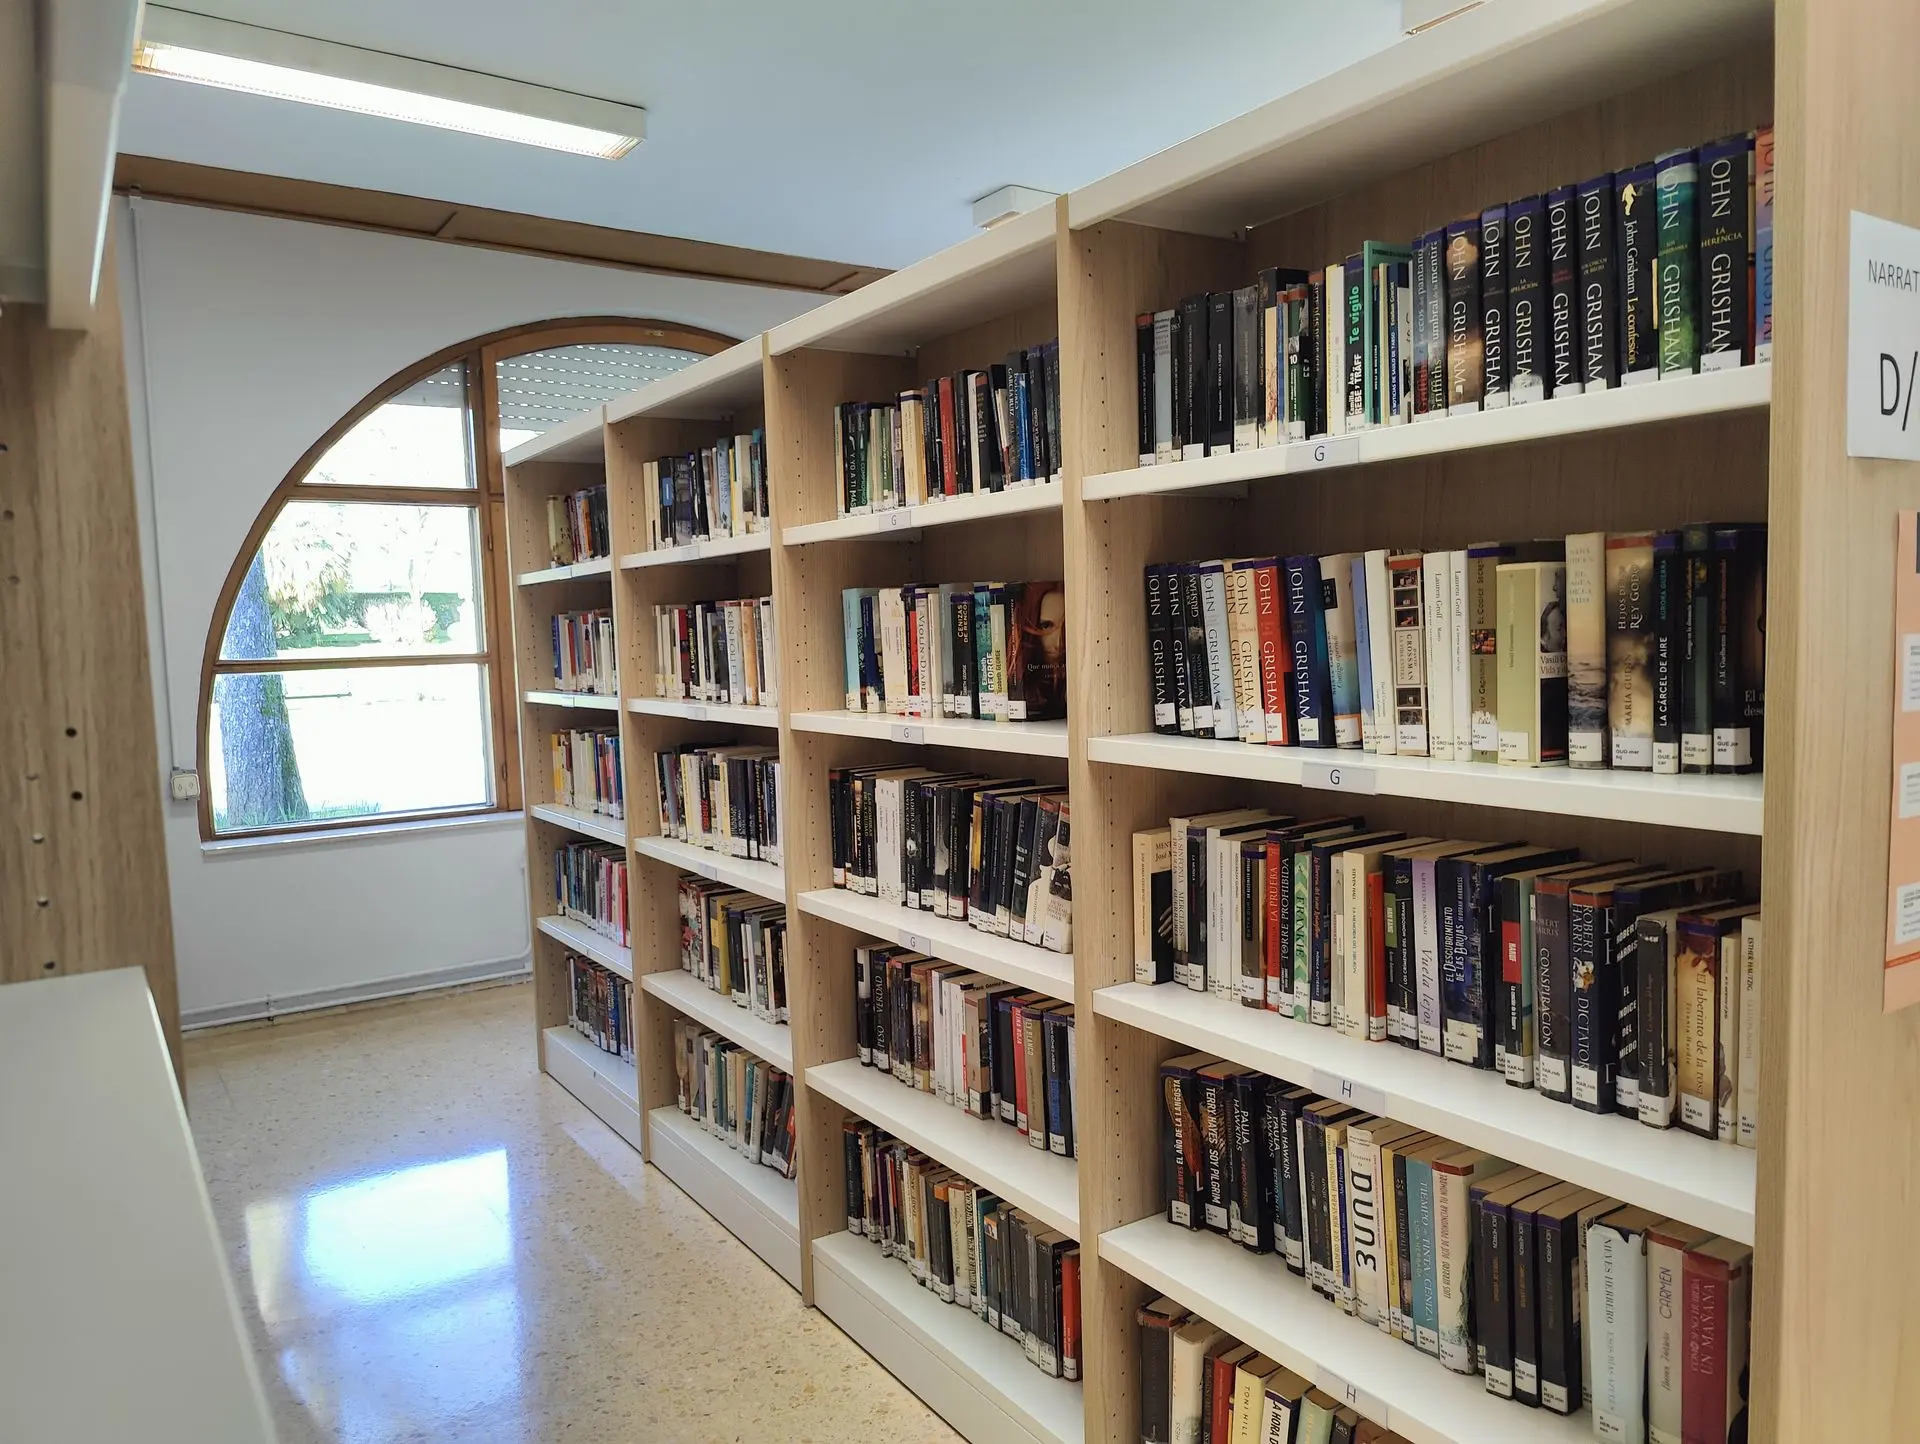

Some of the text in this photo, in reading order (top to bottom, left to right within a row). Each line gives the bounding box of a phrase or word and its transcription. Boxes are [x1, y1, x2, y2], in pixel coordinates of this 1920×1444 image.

[1661, 174, 1680, 230] OHN
[1711, 159, 1731, 218] OHN
[1514, 215, 1532, 269] OHN
[1314, 446, 1325, 462] G
[919, 659, 928, 694] DIABL
[1330, 769, 1341, 786] G
[1281, 857, 1289, 920] PROHIBIDA
[1296, 896, 1306, 958] FRANKIE
[1540, 946, 1553, 1047] CONSPIRACIÓN
[1342, 1080, 1353, 1098] H
[1280, 1109, 1289, 1133] AULA
[1208, 1148, 1218, 1166] SOY
[1658, 1266, 1673, 1320] CARMEN
[1347, 1383, 1357, 1404] H
[1269, 1411, 1281, 1437] HORA
